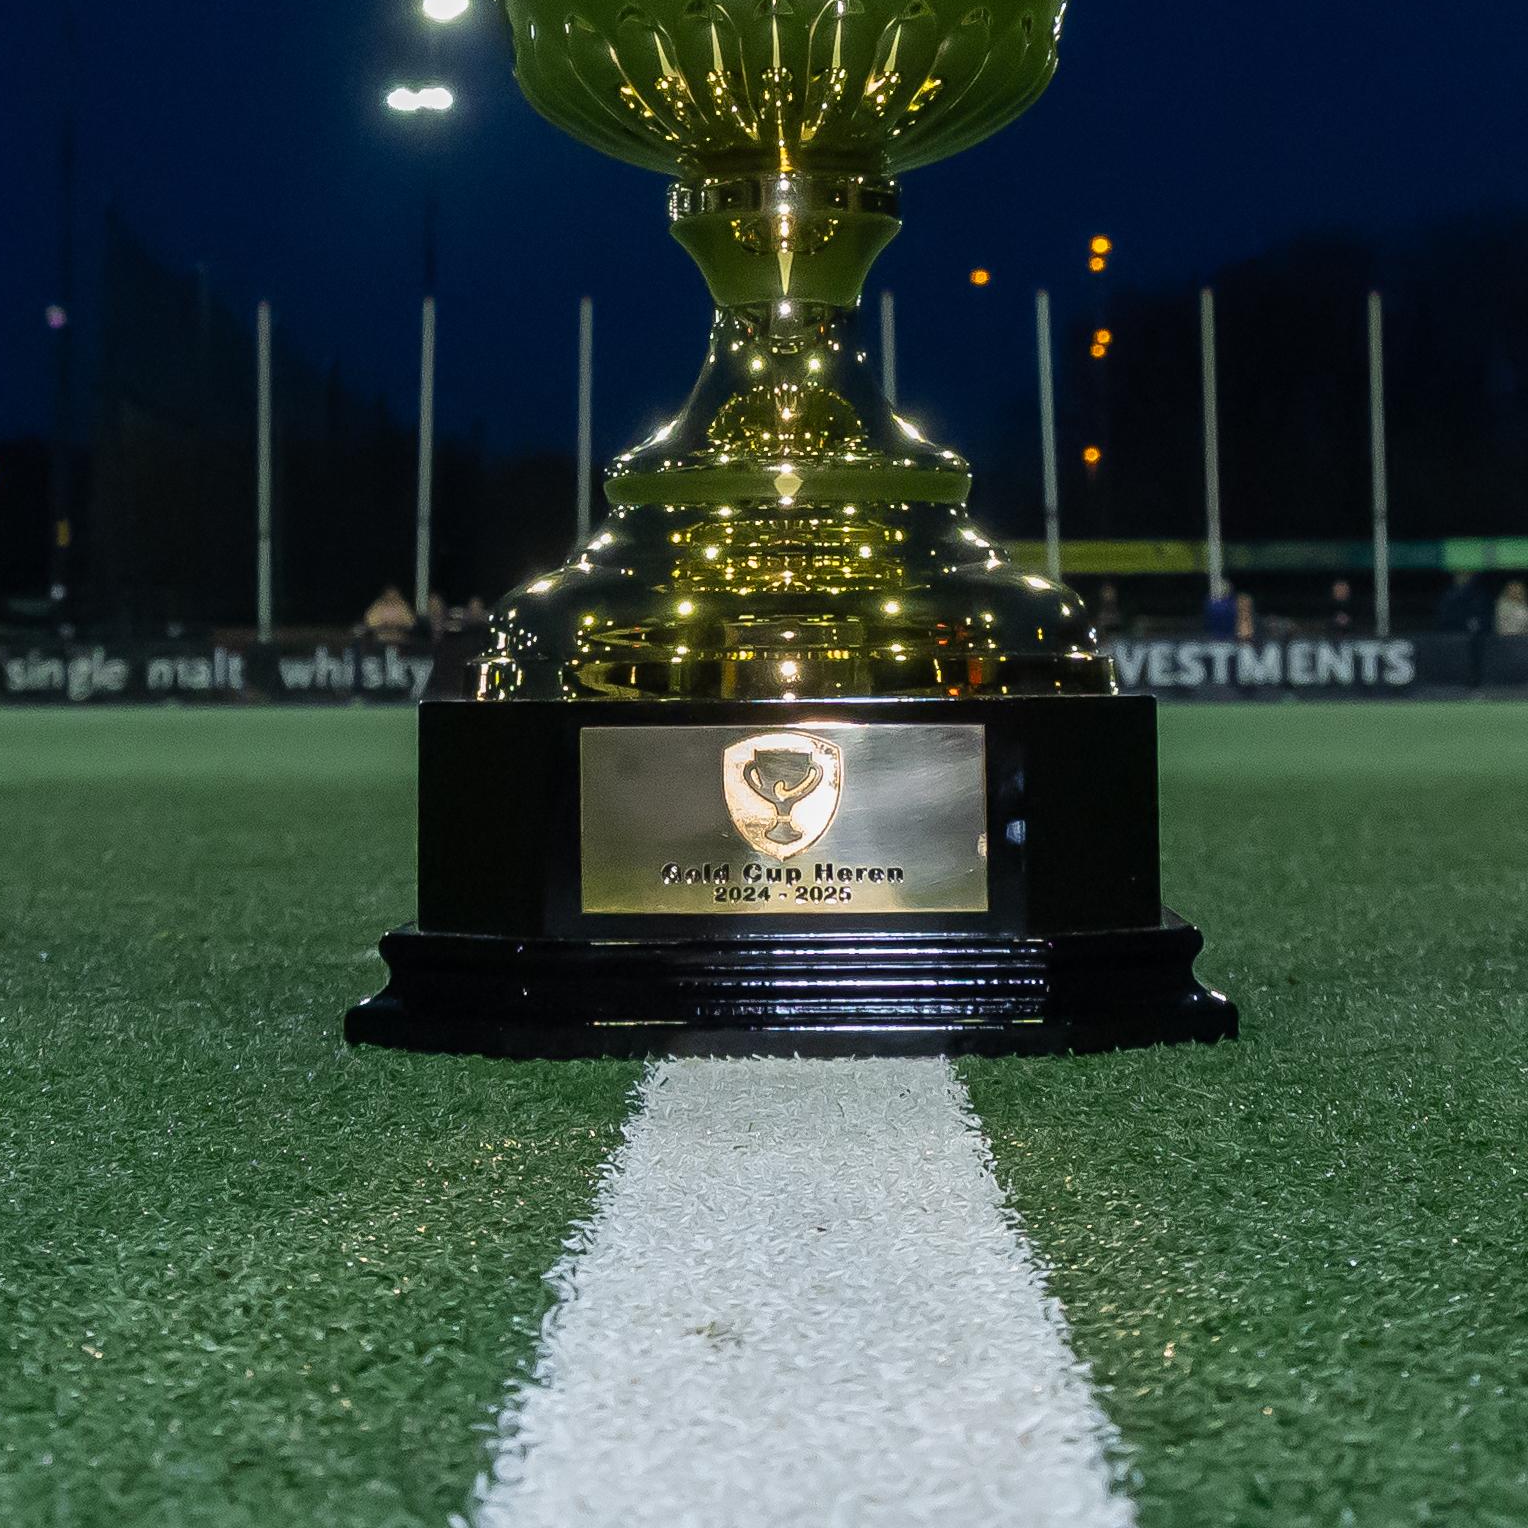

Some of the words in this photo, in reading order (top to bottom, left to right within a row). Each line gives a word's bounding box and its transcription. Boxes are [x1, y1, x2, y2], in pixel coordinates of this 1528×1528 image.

[3, 645, 129, 702] single
[145, 646, 244, 691] malt
[278, 645, 434, 700] whisky
[1112, 638, 1416, 686] VESTMENTS
[661, 862, 730, 884] Gold
[742, 862, 802, 887] Cup
[814, 862, 904, 884] Heren
[713, 885, 771, 903] 2024
[794, 885, 853, 904] 2025
